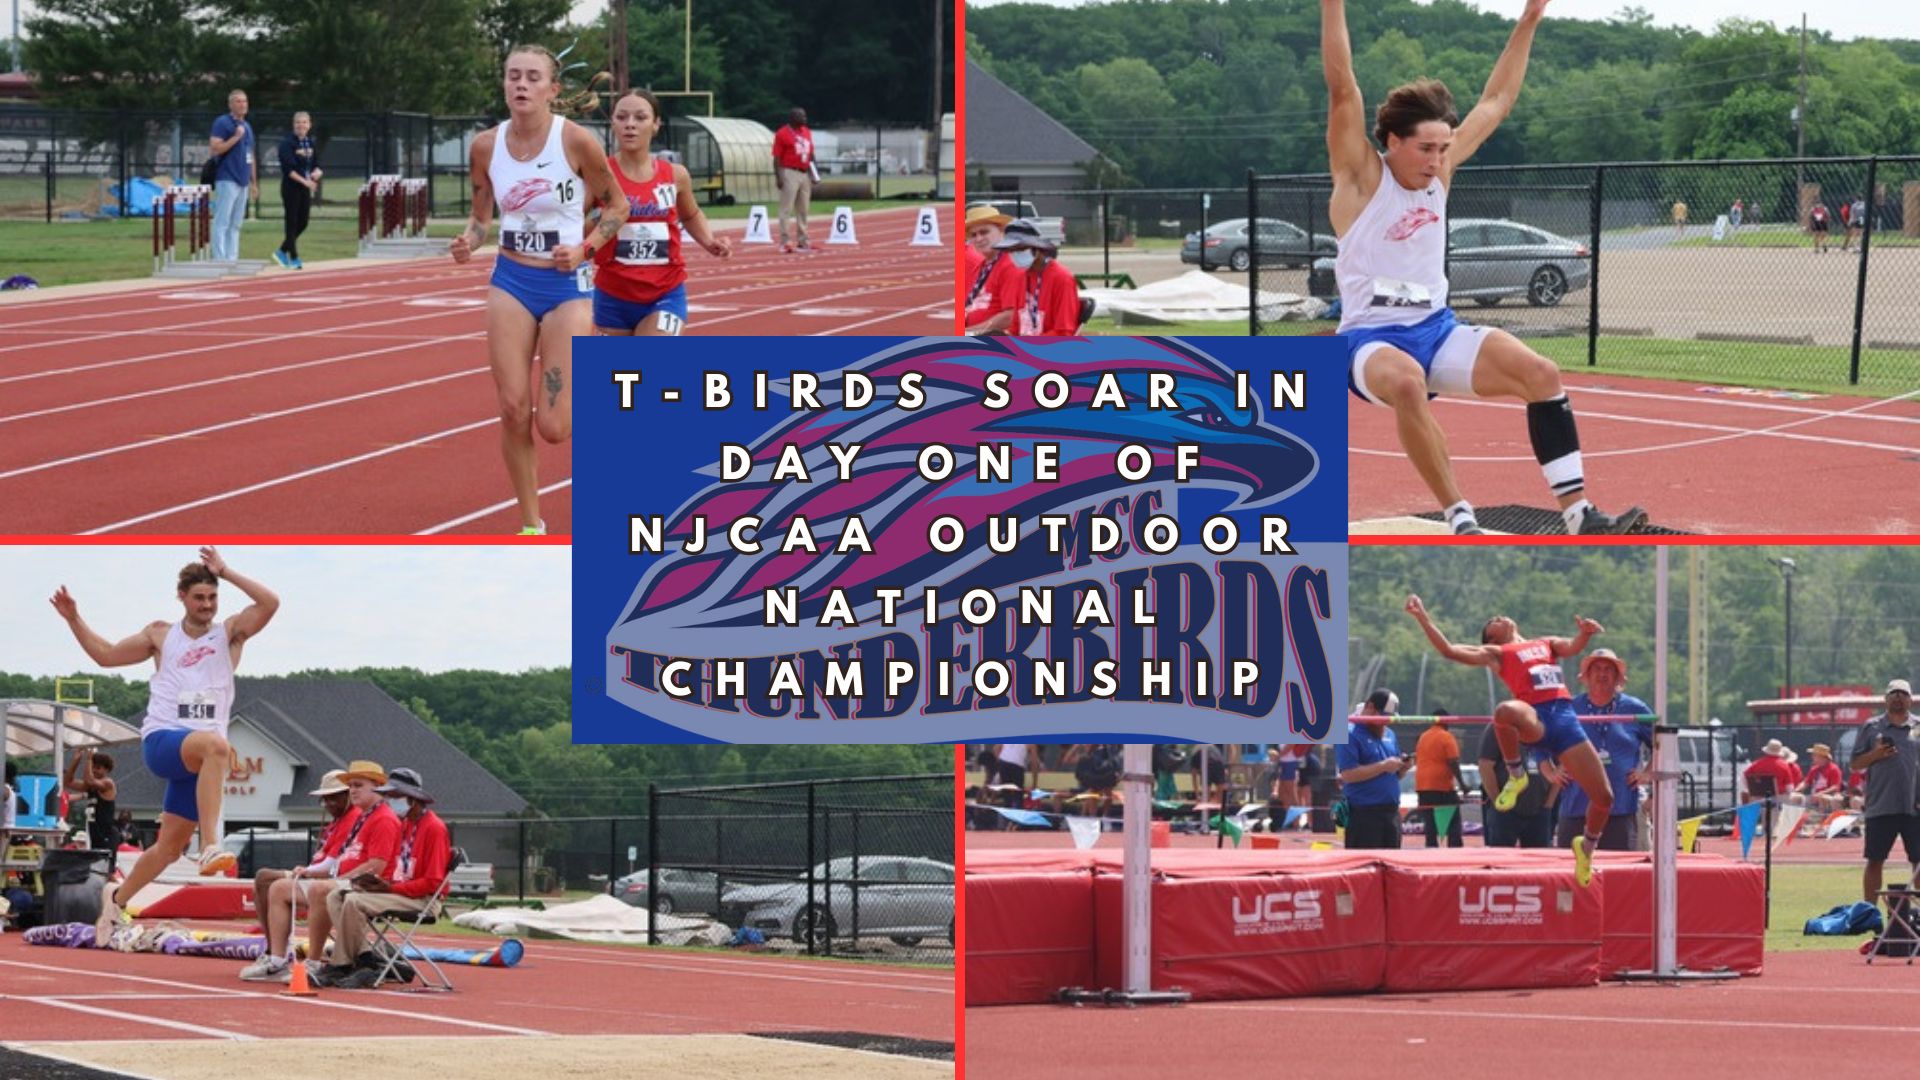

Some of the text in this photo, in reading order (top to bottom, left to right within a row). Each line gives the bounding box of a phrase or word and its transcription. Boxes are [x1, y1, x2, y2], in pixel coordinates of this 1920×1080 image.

[556, 179, 574, 204] 16
[658, 186, 676, 207] 11
[753, 214, 763, 233] 7
[836, 214, 847, 233] 6
[921, 215, 932, 234] 5
[514, 232, 546, 252] 520
[628, 241, 658, 259] 352
[663, 312, 680, 335] 11
[1232, 890, 1322, 923] UCS
[1459, 886, 1542, 913] UCS
